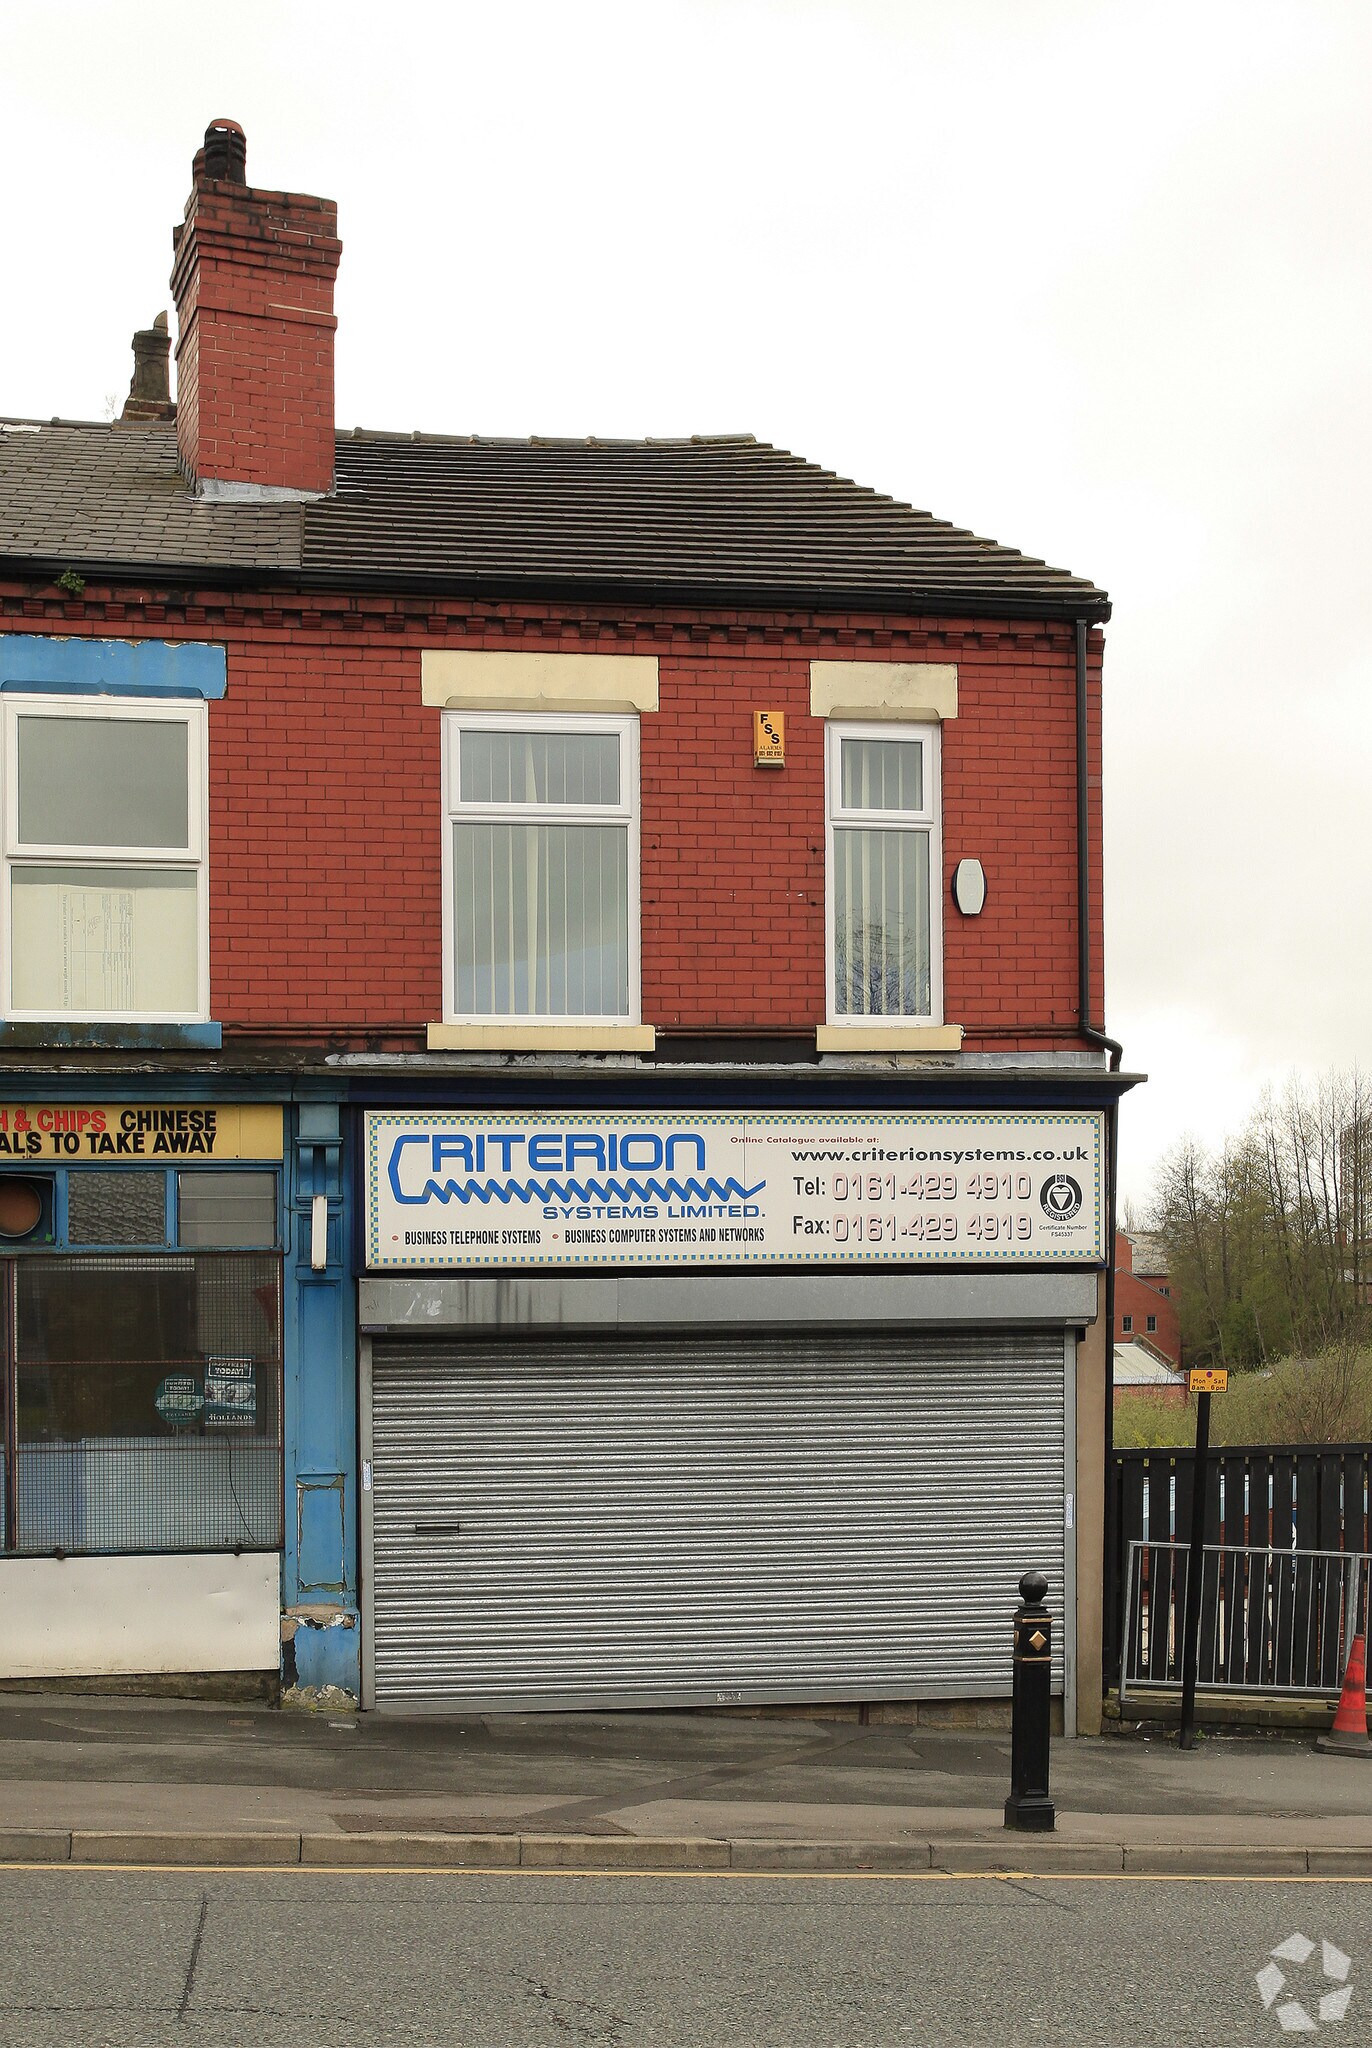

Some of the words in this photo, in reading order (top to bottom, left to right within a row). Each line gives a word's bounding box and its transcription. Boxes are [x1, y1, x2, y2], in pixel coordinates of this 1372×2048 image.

[14, 1109, 32, 1132] &
[37, 1109, 106, 1132] CHIPS
[120, 1110, 216, 1132] CHINESE
[50, 1132, 80, 1154] TO
[86, 1132, 145, 1154] TAKE
[152, 1132, 216, 1154] AWAY
[730, 1136, 763, 1144] Online
[766, 1136, 816, 1144] Catalogue
[818, 1136, 864, 1144] available
[791, 1147, 1089, 1164] www.criterionsystems.co.uk
[388, 1133, 706, 1204] CRITERION
[793, 1176, 826, 1195] Tel:
[831, 1171, 958, 1200] 0161-429
[965, 1171, 1032, 1199] 4910
[542, 1206, 659, 1220] SYSTEMS
[667, 1205, 766, 1218] LIMITED.
[1042, 1202, 1081, 1220] REGISTERED
[565, 1229, 606, 1243] BUSINESS
[609, 1229, 656, 1243] COMPUTER
[658, 1229, 697, 1242] SYSTEMS
[700, 1229, 716, 1242] AND
[718, 1228, 765, 1242] NETWORKS
[793, 1215, 830, 1234] Fax:
[832, 1213, 958, 1241] 0161-429
[966, 1212, 1032, 1240] 4919
[404, 1231, 447, 1245] BUSINESS
[450, 1230, 499, 1245] TELEPHONE
[501, 1230, 541, 1244] SYSTEMS
